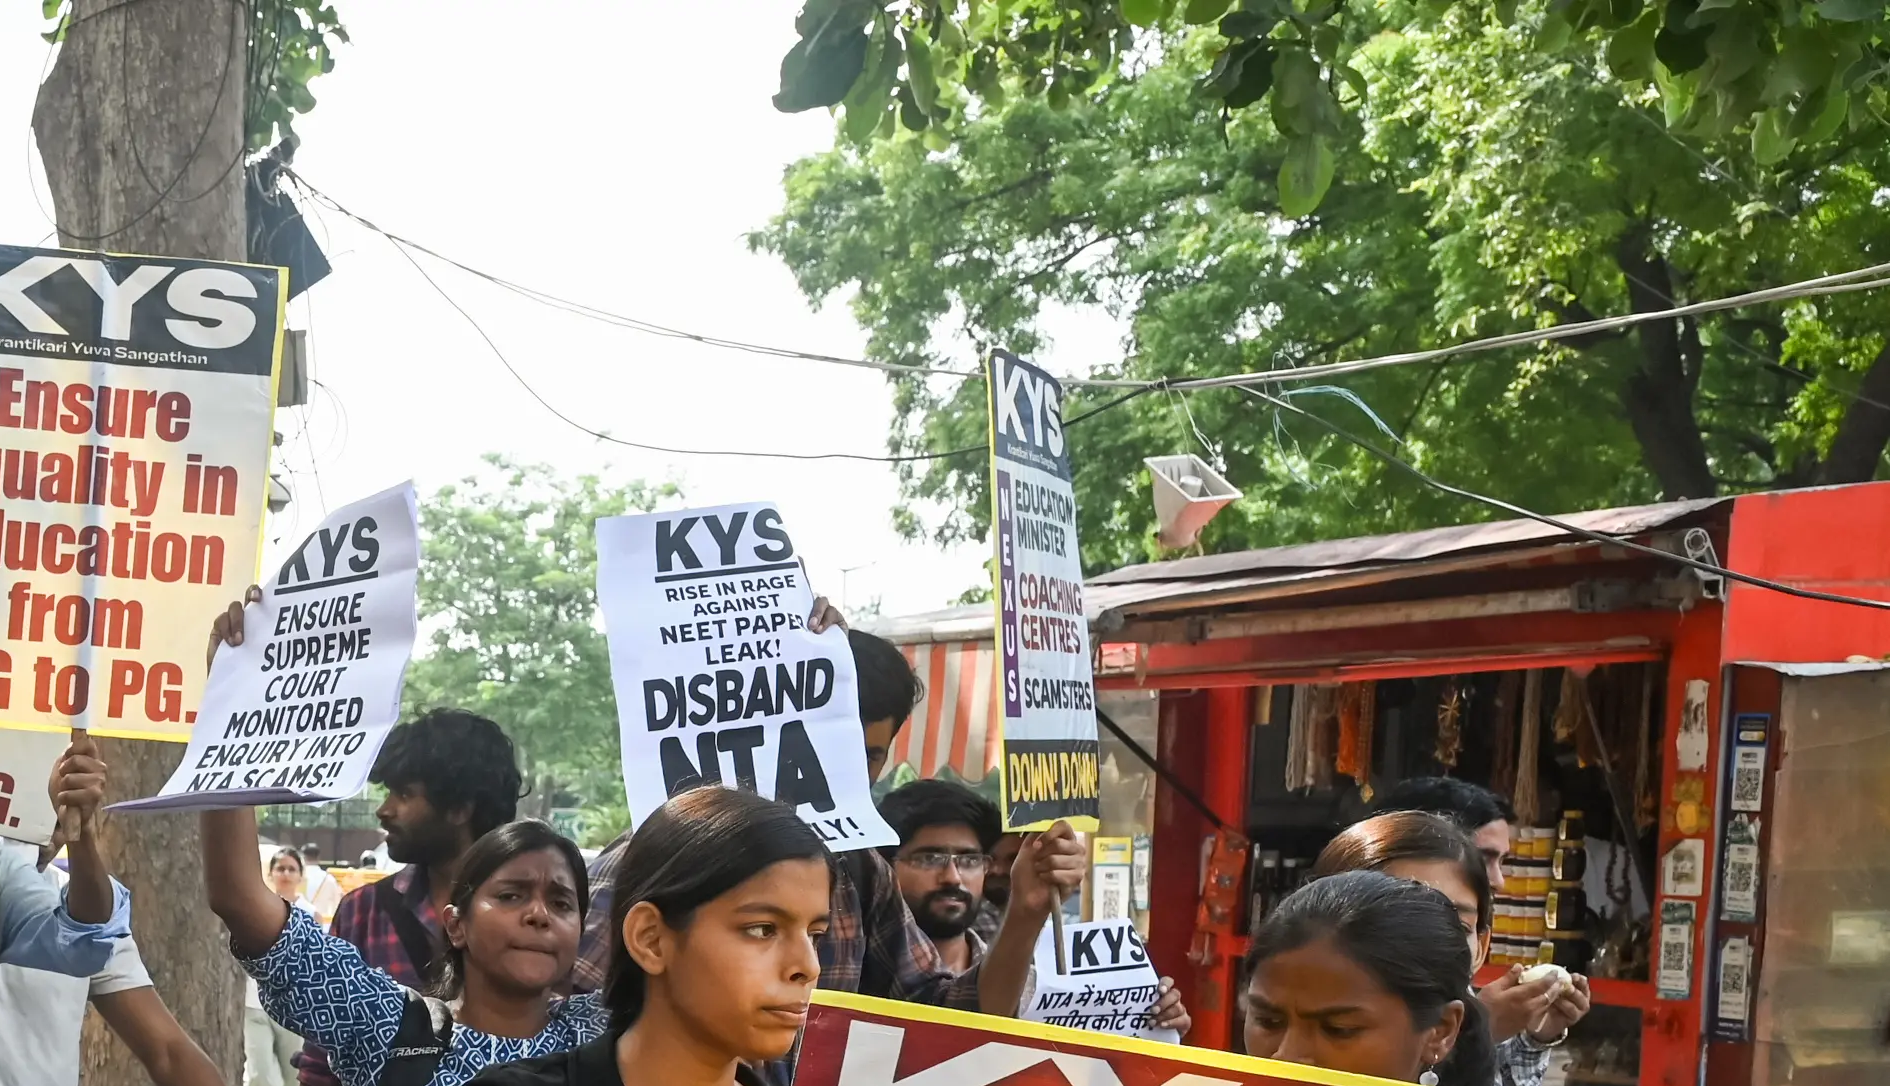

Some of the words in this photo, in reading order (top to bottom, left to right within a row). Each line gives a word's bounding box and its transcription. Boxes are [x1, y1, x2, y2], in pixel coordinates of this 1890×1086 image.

[71, 342, 111, 357] Yuva
[115, 346, 208, 365] Sangathan
[995, 356, 1064, 458] KYS
[183, 454, 239, 516] in
[1015, 479, 1074, 526] EDUCATION
[655, 508, 795, 573] KYS
[1017, 516, 1067, 558] MINISTER
[665, 584, 712, 602] RISE
[716, 581, 737, 597] IN
[742, 574, 797, 593] RAGE
[693, 593, 780, 617] AGAINST
[1019, 572, 1083, 616] COACHING
[7, 581, 144, 650] from
[274, 592, 366, 636] ENSURE
[660, 619, 727, 645] NEET
[1021, 614, 1080, 654] CENTRES
[261, 628, 371, 672] SUPREME
[705, 639, 782, 665] LEAK!
[33, 656, 90, 716] to
[107, 660, 199, 724] PG.
[265, 667, 347, 702] COURT
[643, 657, 835, 732] DISBAND
[1024, 677, 1092, 711] SCAMSTERS
[223, 697, 364, 739] MONITORED
[195, 738, 308, 769] ENQUIRY
[304, 732, 366, 759] INTO
[660, 719, 836, 813] NTA
[186, 771, 235, 792] NTA
[243, 761, 345, 789] SCAMS!!
[1010, 752, 1059, 802] DOWN!
[1072, 925, 1146, 968] KYS
[1036, 992, 1073, 1011] NTA
[1076, 984, 1095, 1007] में
